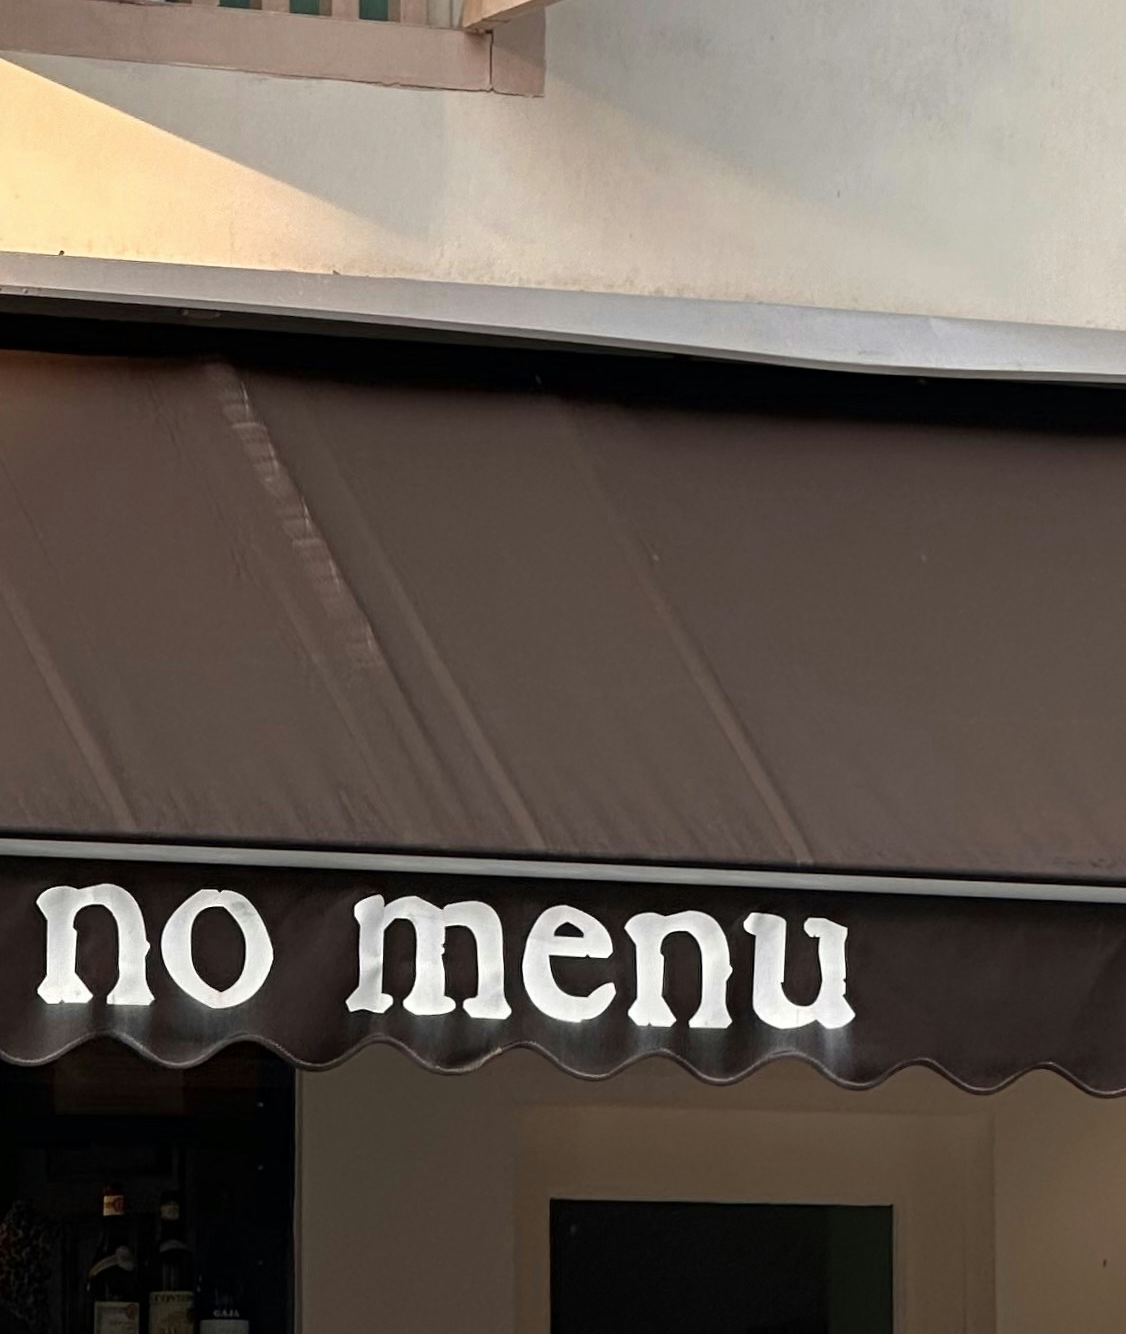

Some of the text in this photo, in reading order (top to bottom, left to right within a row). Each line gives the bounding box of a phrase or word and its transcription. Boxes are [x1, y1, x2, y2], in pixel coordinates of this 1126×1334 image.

[36, 883, 857, 1032] no menu
[213, 1309, 240, 1319] GAJA
